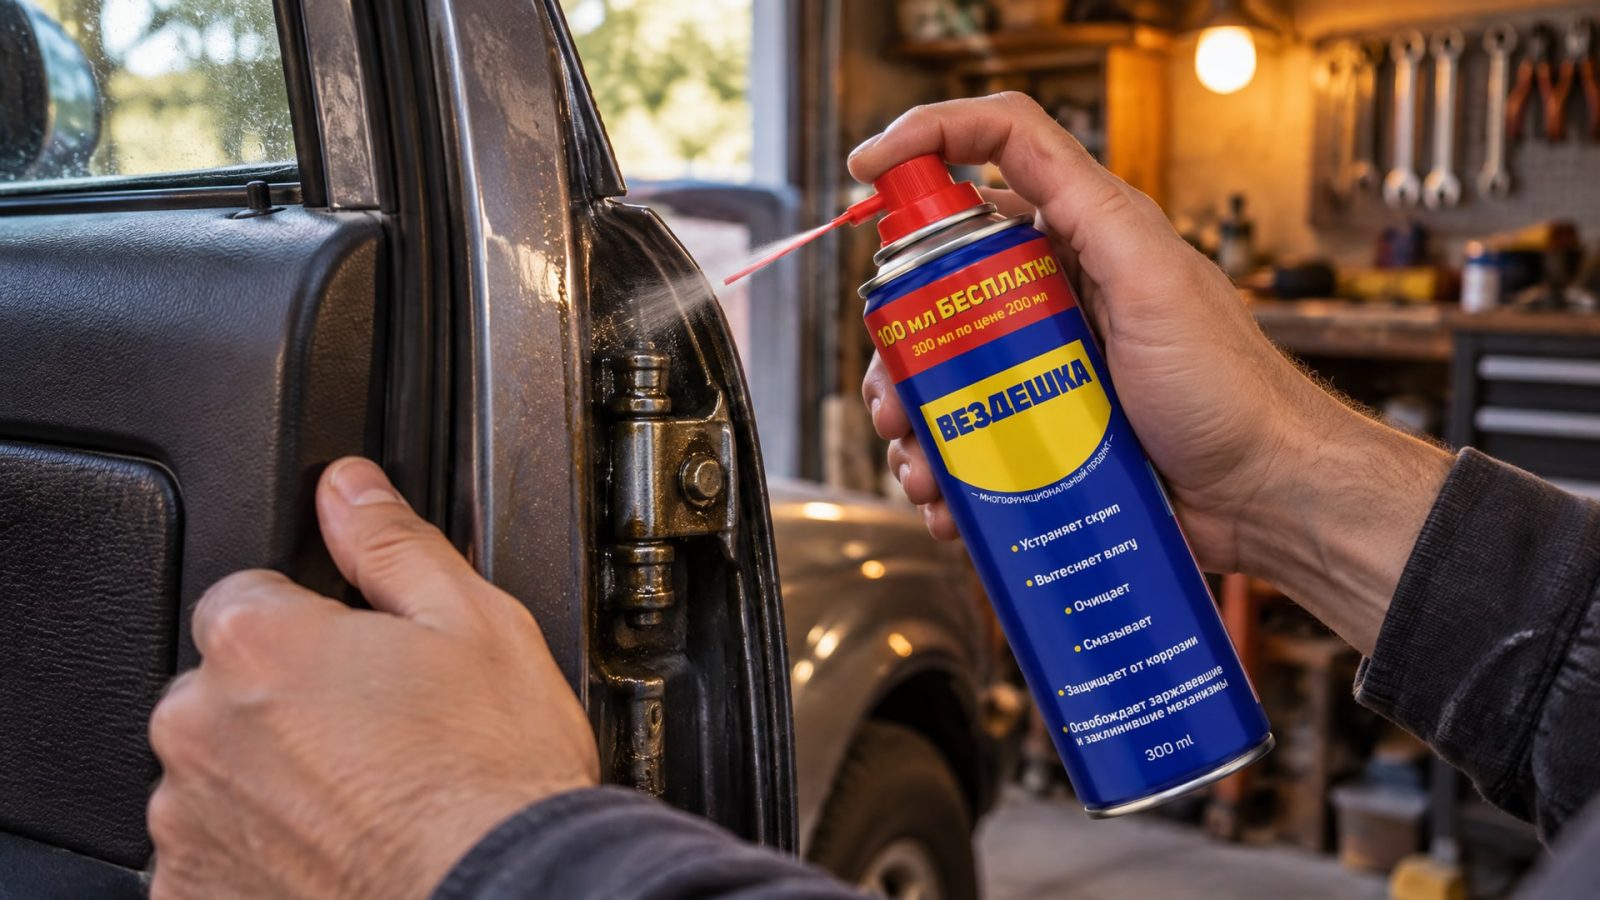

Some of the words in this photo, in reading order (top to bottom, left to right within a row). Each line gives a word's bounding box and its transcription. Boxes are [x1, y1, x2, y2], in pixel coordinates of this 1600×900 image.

[877, 321, 907, 348] 100
[907, 310, 938, 335] мл
[936, 255, 1058, 319] БЕСПЛАТНО
[912, 338, 935, 357] 300
[937, 332, 955, 348] мл
[956, 324, 972, 341] по
[974, 308, 1006, 332] цене
[1005, 296, 1031, 316] 200
[1032, 292, 1049, 305] мл
[935, 358, 1093, 442] ВЕЗДЕШКА
[1019, 520, 1083, 551] Устраняет
[1084, 503, 1121, 526] скрип
[1034, 553, 1102, 587] Вытесняет
[1103, 538, 1138, 560] влагу
[1074, 583, 1130, 612] Очищает
[1083, 616, 1152, 651] Смазывает
[1065, 668, 1127, 697] Защищает
[1130, 661, 1144, 674] от
[1146, 636, 1199, 667] коррозии
[1069, 701, 1146, 733] Освобождает
[1149, 665, 1224, 707] заржавевшие
[1076, 736, 1084, 746] и
[1084, 709, 1165, 745] заклинившие
[1166, 678, 1229, 715] механизмы
[1145, 742, 1174, 761] 300
[1175, 734, 1195, 749] ml
